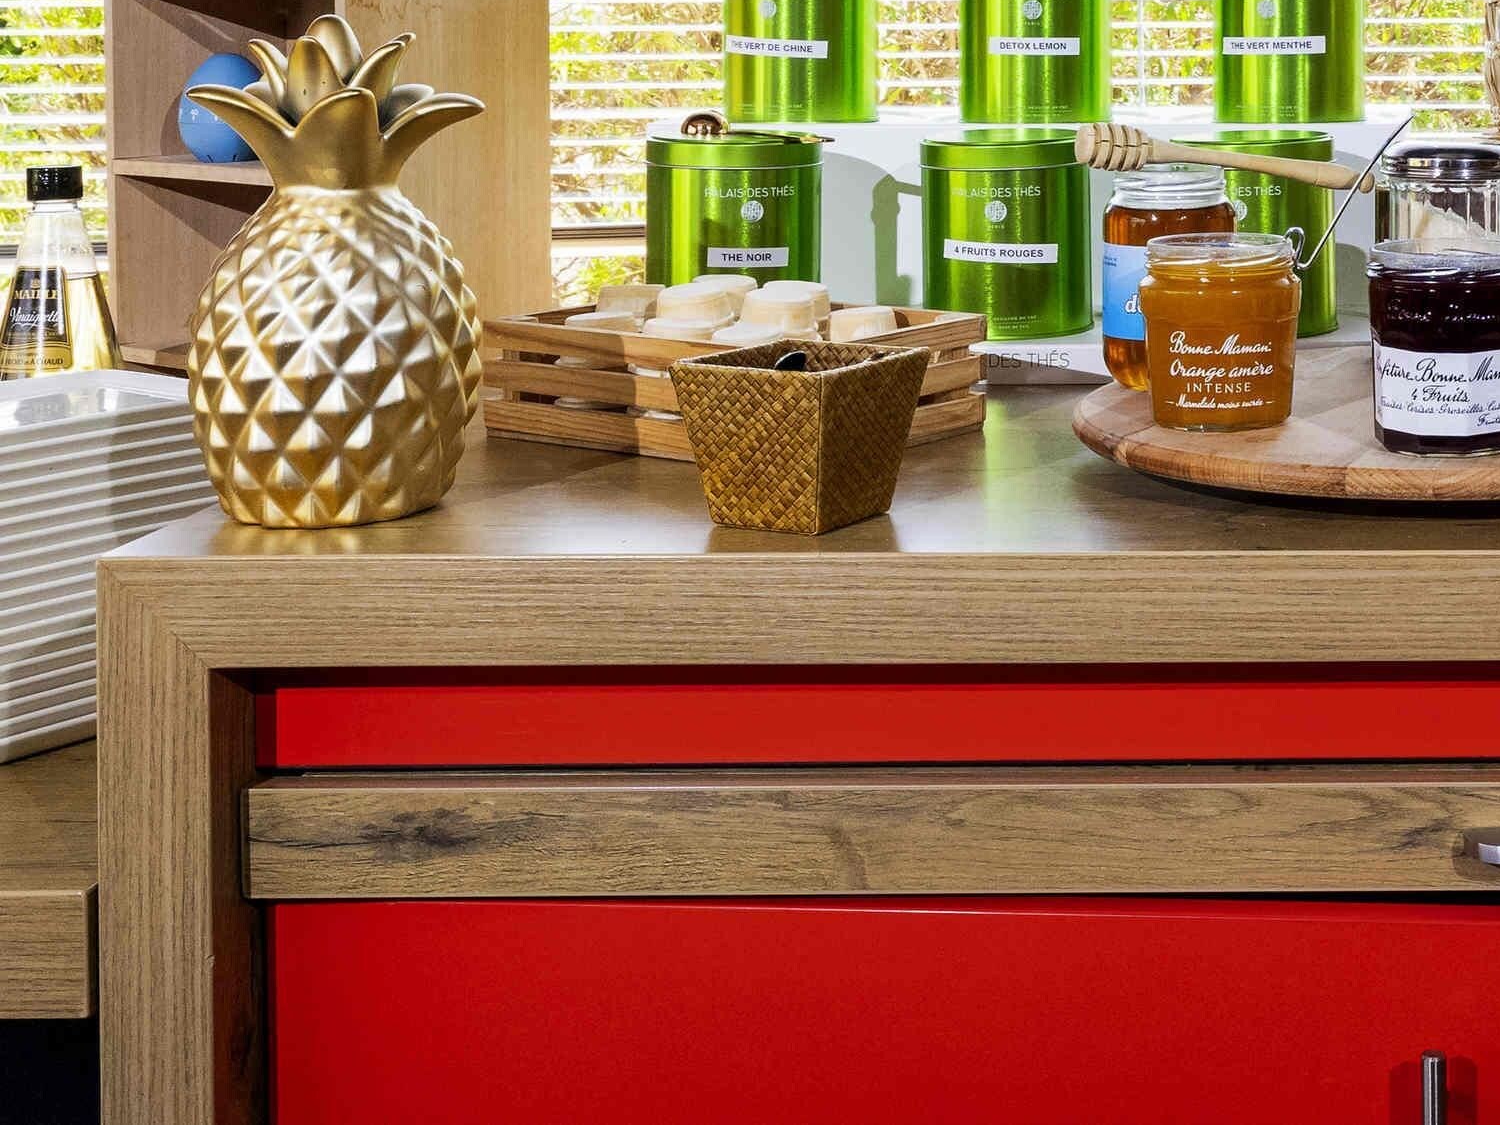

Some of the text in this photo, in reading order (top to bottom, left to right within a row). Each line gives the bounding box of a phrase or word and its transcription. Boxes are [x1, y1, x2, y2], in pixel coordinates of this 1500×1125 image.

[745, 42, 766, 51] VERT
[767, 43, 781, 52] DE
[783, 44, 813, 53] CHINE
[1000, 41, 1067, 50] DETOX LEMON
[1231, 40, 1312, 50] THE VERT MENTHE
[704, 184, 795, 198] PALAIS DES THÉS
[990, 186, 1012, 198] DES
[1014, 184, 1041, 197] THÉS
[1254, 185, 1282, 197] THÉS
[722, 253, 772, 262] THE NOIR
[954, 246, 1044, 258] 4 FRUITS ROUGES
[1169, 330, 1213, 355] Bonne
[988, 349, 1070, 368] DES THÉS
[1170, 358, 1274, 382] Orange amère
[1415, 357, 1467, 382] Bonne
[1186, 382, 1252, 393] INTENSE
[1410, 384, 1471, 403] 4 Fruits
